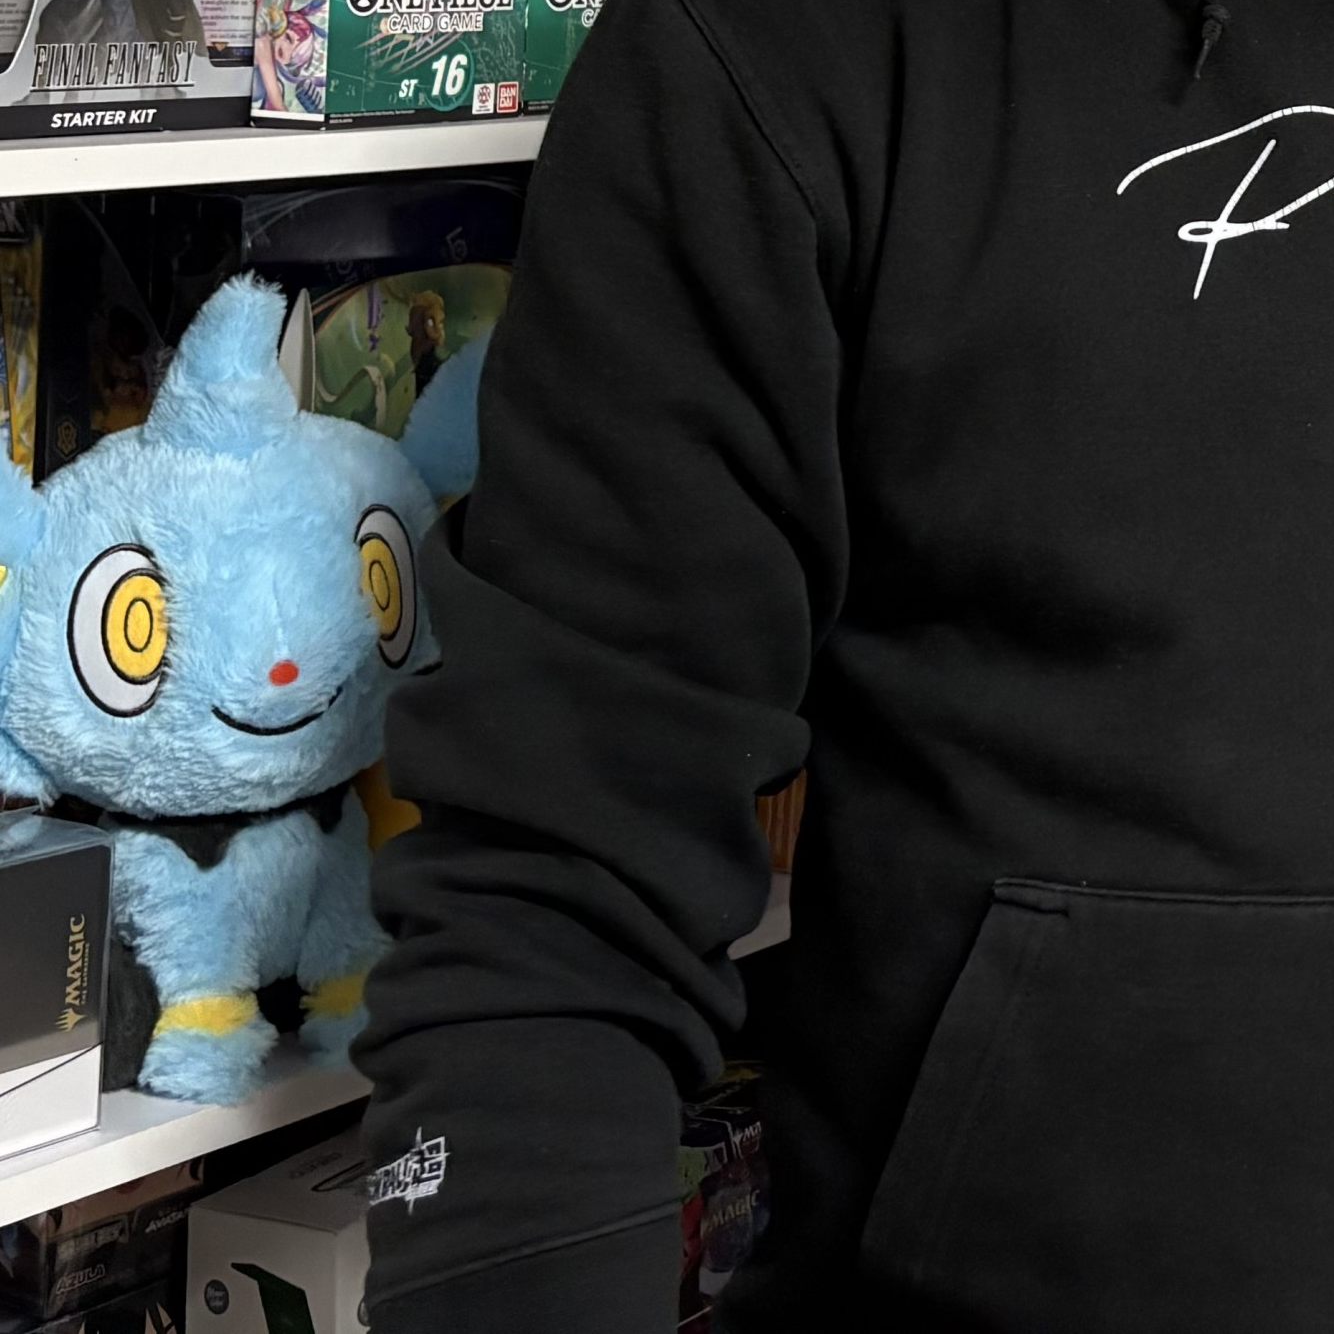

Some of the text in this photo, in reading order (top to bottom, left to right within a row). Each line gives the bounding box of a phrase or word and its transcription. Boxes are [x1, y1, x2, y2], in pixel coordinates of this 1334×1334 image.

[389, 14, 483, 32] CARD GAME
[32, 41, 197, 88] FINAL FANTASY
[399, 53, 468, 98] ST 16
[51, 109, 157, 128] STARTER KIT
[65, 912, 85, 1006] MAGIC
[707, 1188, 761, 1230] MAGIC
